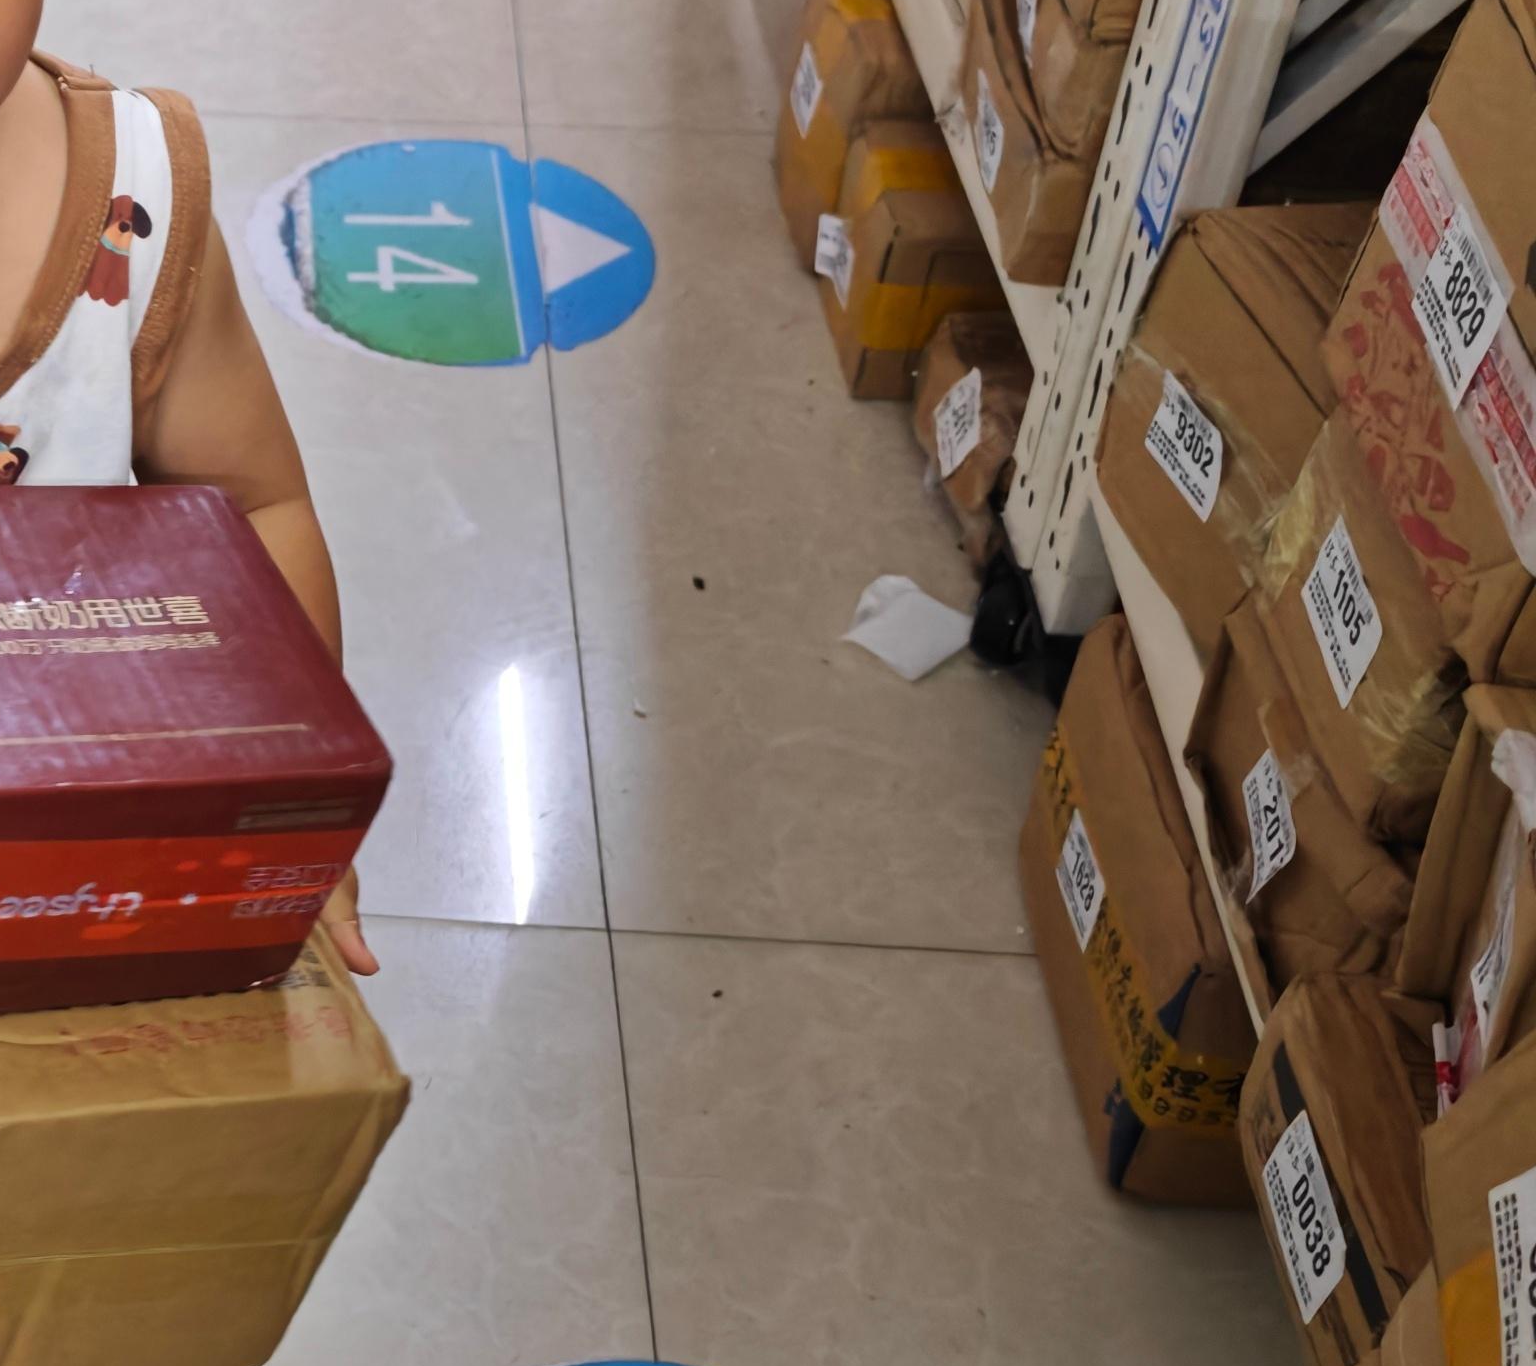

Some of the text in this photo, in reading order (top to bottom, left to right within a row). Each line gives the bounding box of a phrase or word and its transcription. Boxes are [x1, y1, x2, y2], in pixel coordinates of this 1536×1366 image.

[343, 201, 478, 292] 14
[1445, 260, 1486, 348] 8829
[1175, 411, 1214, 478] 9302
[1333, 569, 1365, 646] 1105
[1263, 794, 1285, 864] 201
[1292, 1173, 1331, 1278] 0038
